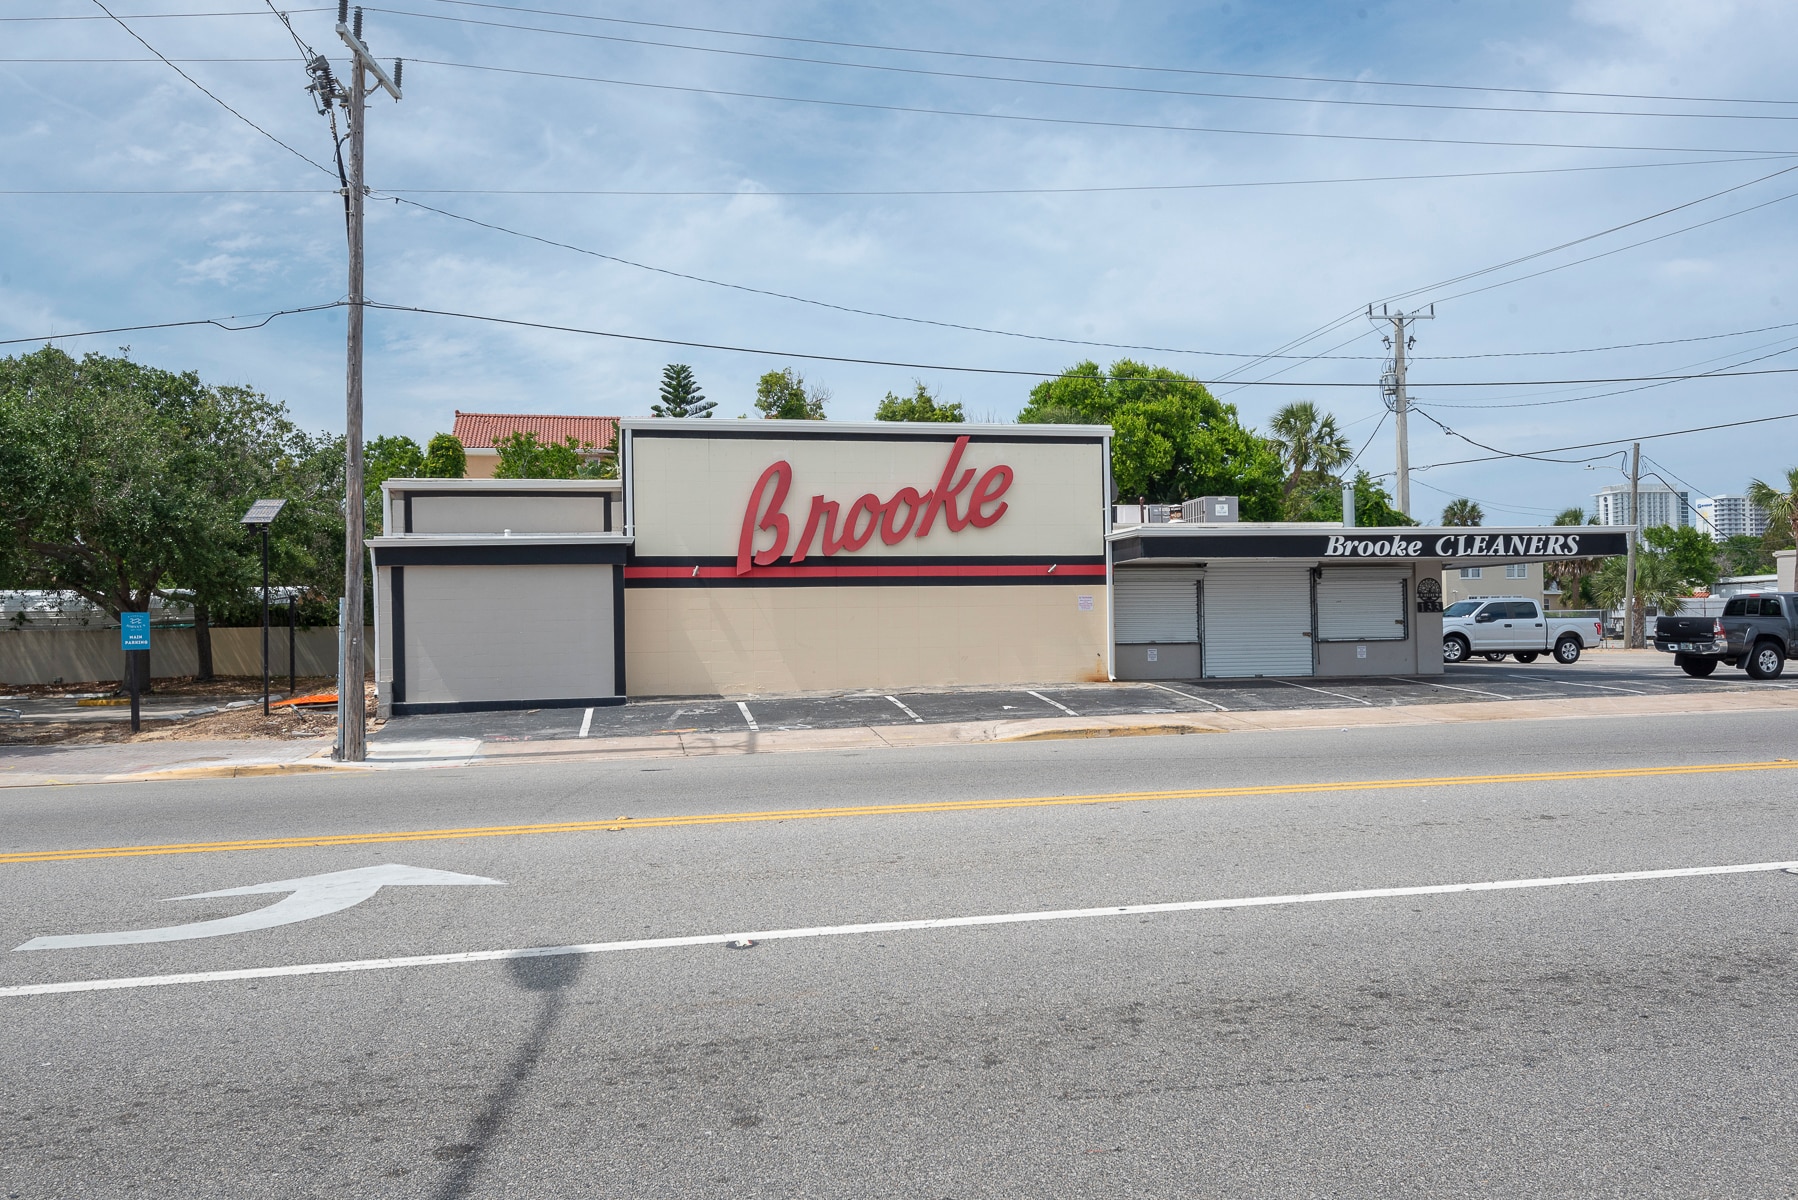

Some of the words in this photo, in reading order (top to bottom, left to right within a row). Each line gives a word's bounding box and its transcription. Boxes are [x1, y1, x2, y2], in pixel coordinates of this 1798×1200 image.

[737, 435, 1014, 576] Brooke
[1324, 535, 1423, 557] Brooke
[1435, 534, 1580, 557] CLEANERS
[1419, 602, 1441, 612] 133
